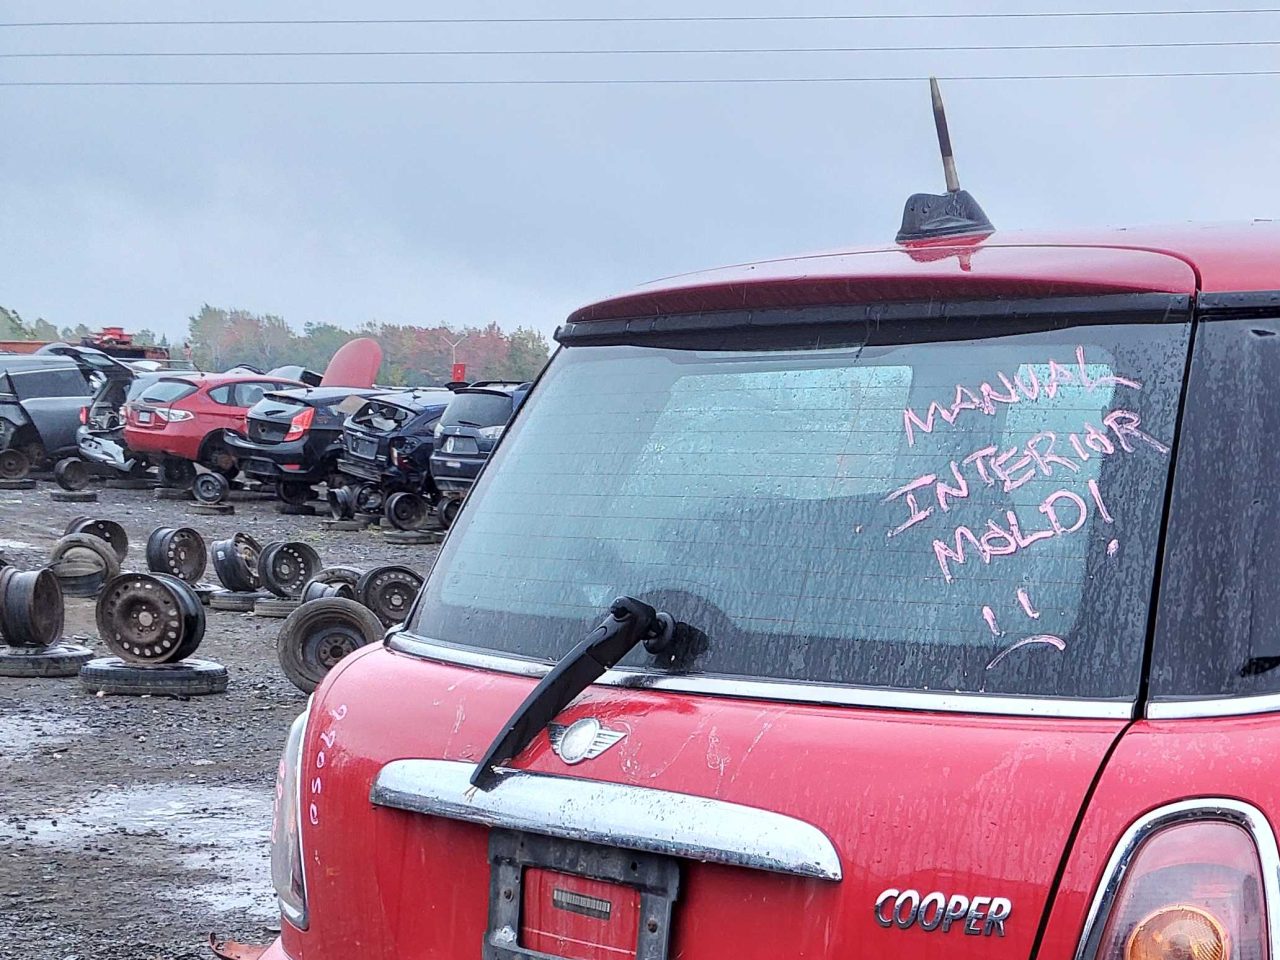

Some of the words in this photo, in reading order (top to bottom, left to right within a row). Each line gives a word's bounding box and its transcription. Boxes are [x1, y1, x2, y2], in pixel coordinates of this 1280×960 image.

[904, 345, 1142, 447] MANUAL
[881, 410, 1169, 537] INTERIOR
[933, 480, 1119, 584] MOLD!
[874, 888, 1012, 937] COOPER
